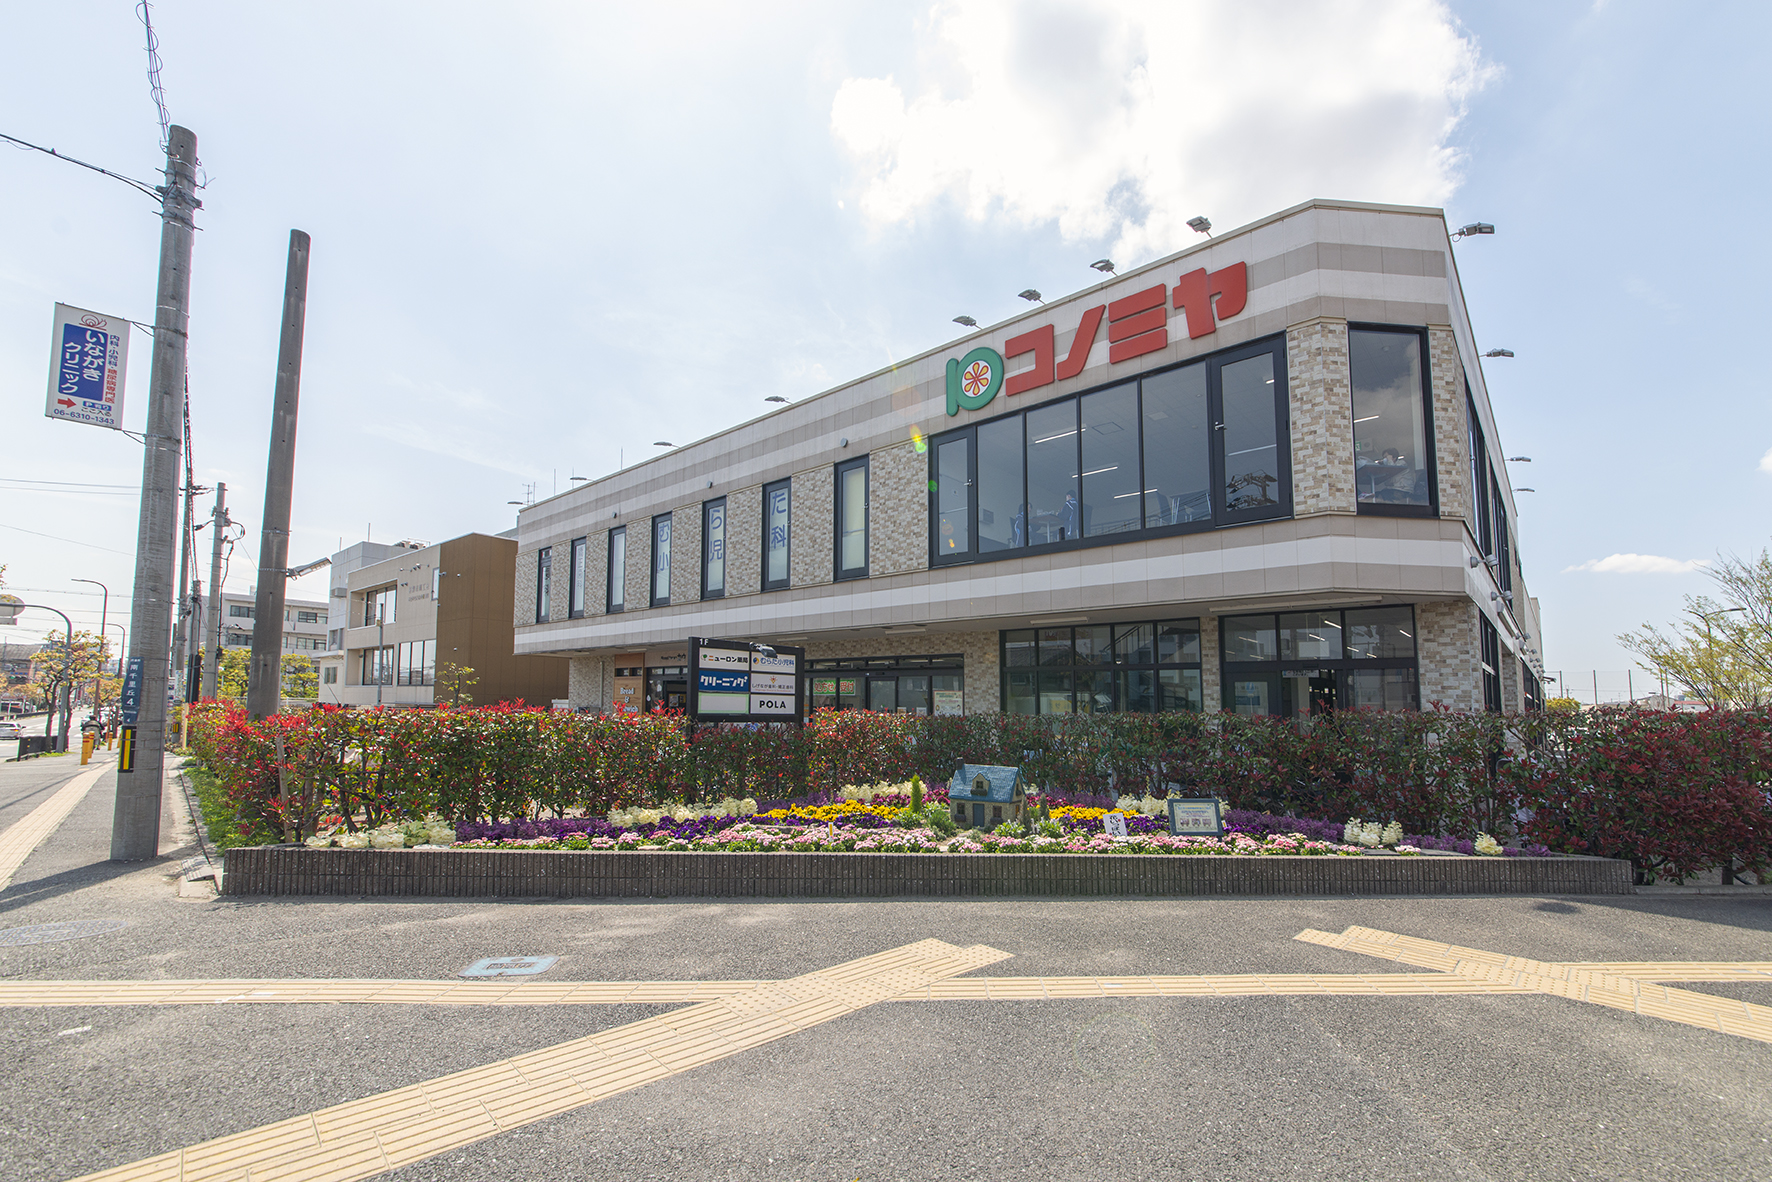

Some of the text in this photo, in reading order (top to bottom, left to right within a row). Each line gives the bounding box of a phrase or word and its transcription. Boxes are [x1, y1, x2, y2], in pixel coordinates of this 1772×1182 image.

[1005, 261, 1247, 396] コノミヤ
[83, 330, 105, 381] いながき
[61, 342, 81, 393] クリニック
[54, 408, 114, 425] 06-6310-1343
[708, 655, 748, 663] ニューロン薬局
[760, 657, 794, 665] むらた小児科
[700, 676, 748, 687] クリーニング
[759, 700, 786, 708] POLA
